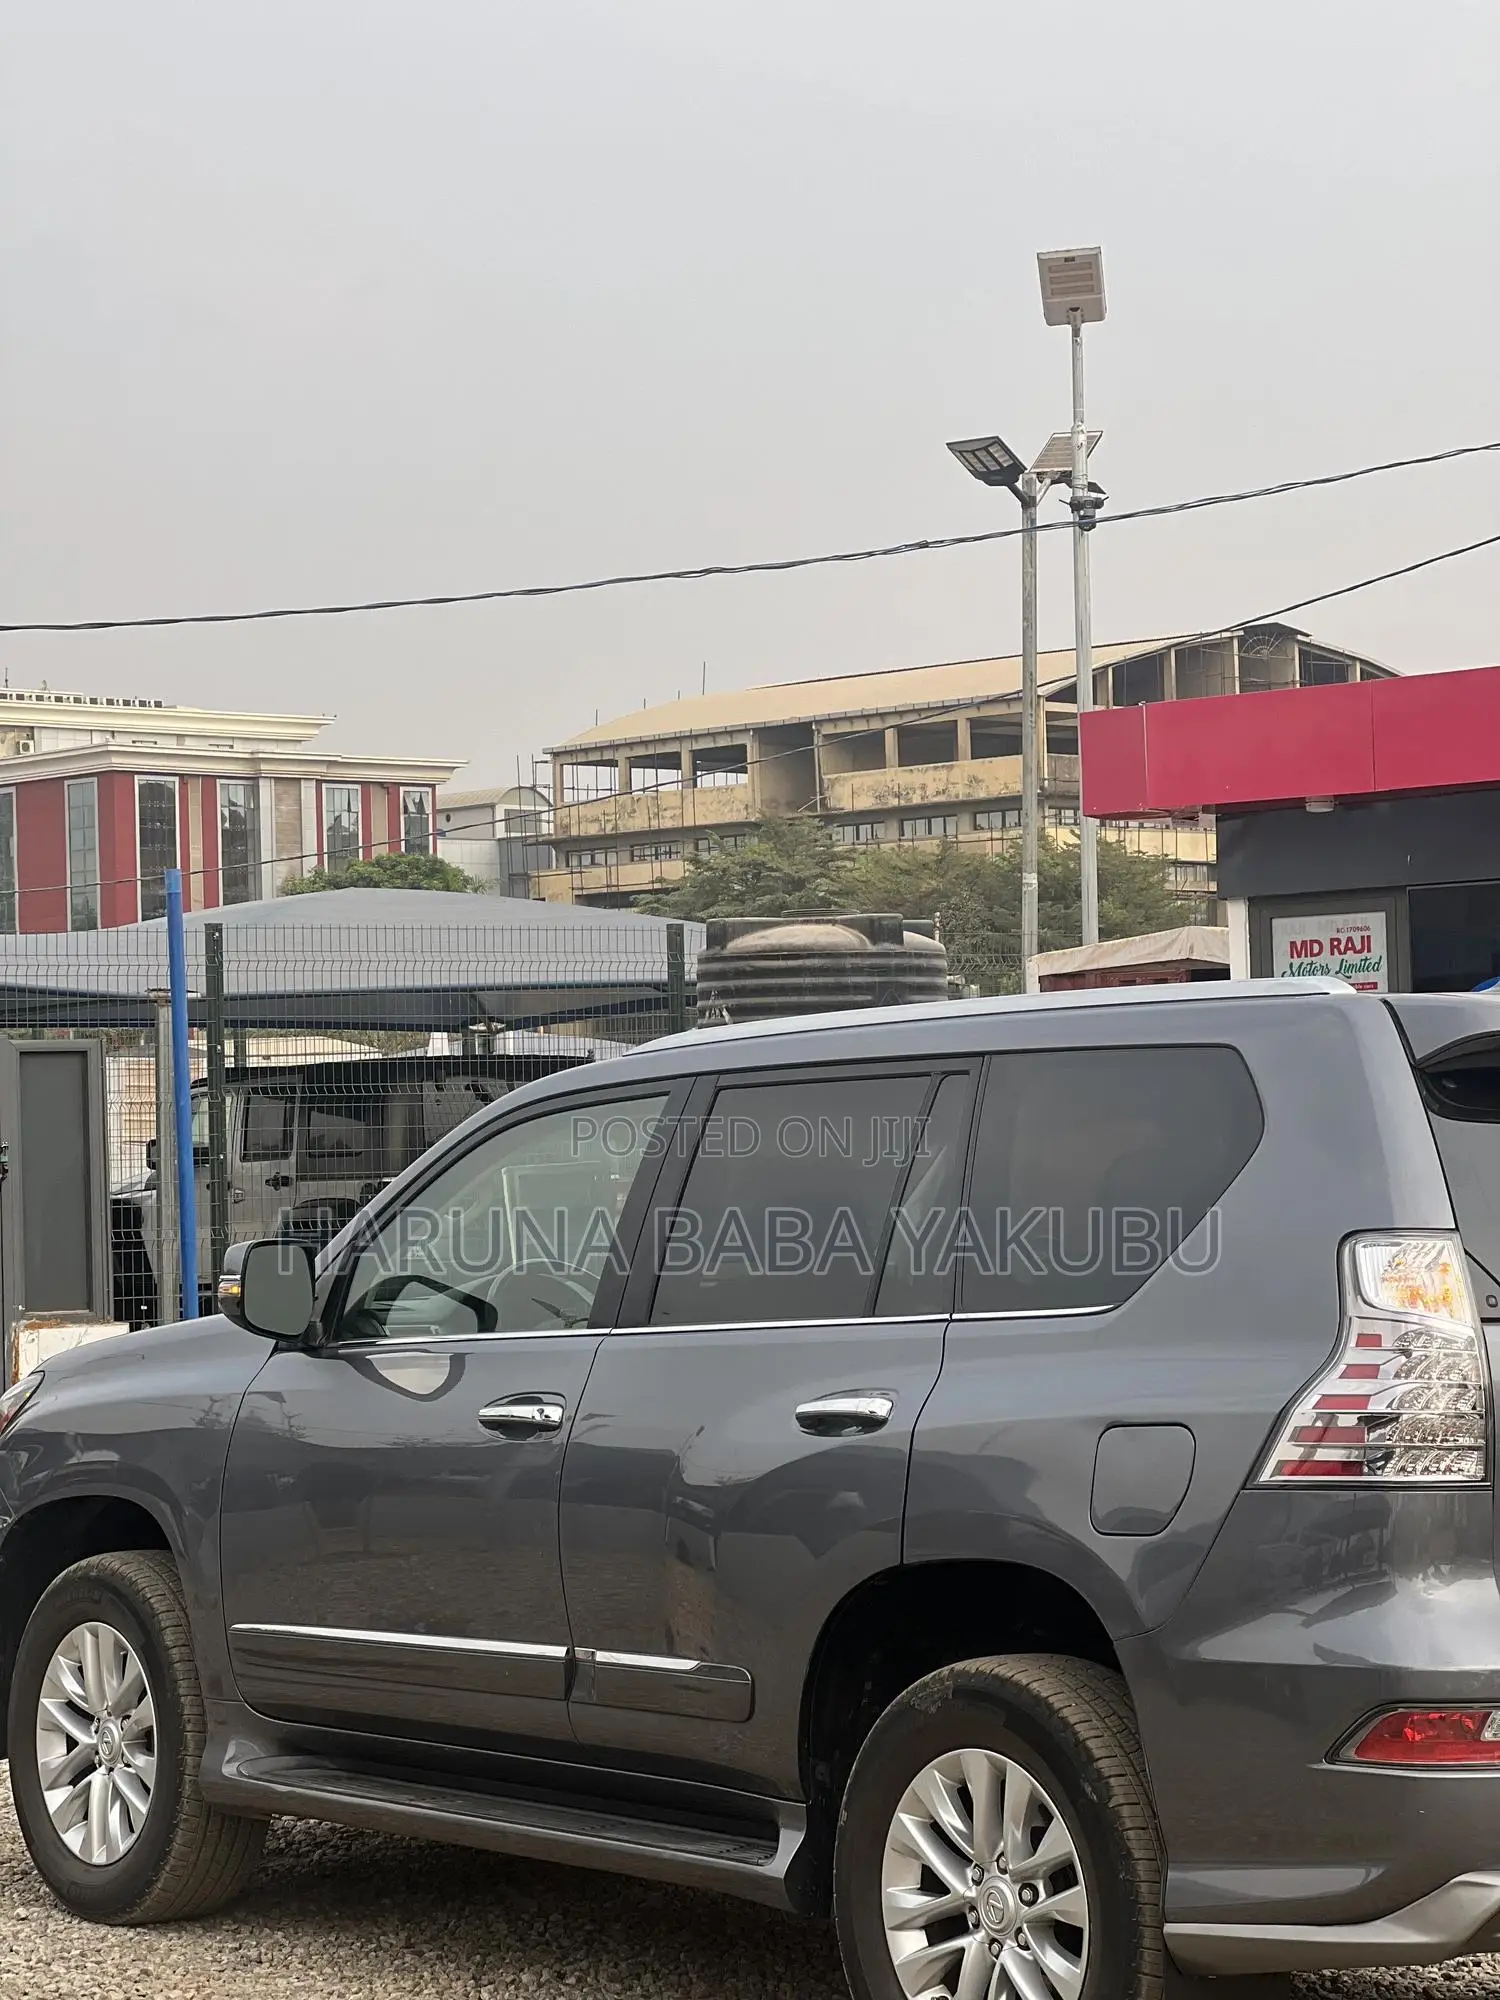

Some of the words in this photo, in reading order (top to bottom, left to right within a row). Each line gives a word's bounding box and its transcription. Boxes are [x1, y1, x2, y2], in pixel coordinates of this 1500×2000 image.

[1289, 939, 1324, 959] MD
[1330, 935, 1371, 955] RAJI
[1281, 960, 1331, 977] Motors
[1335, 955, 1382, 979] Limited
